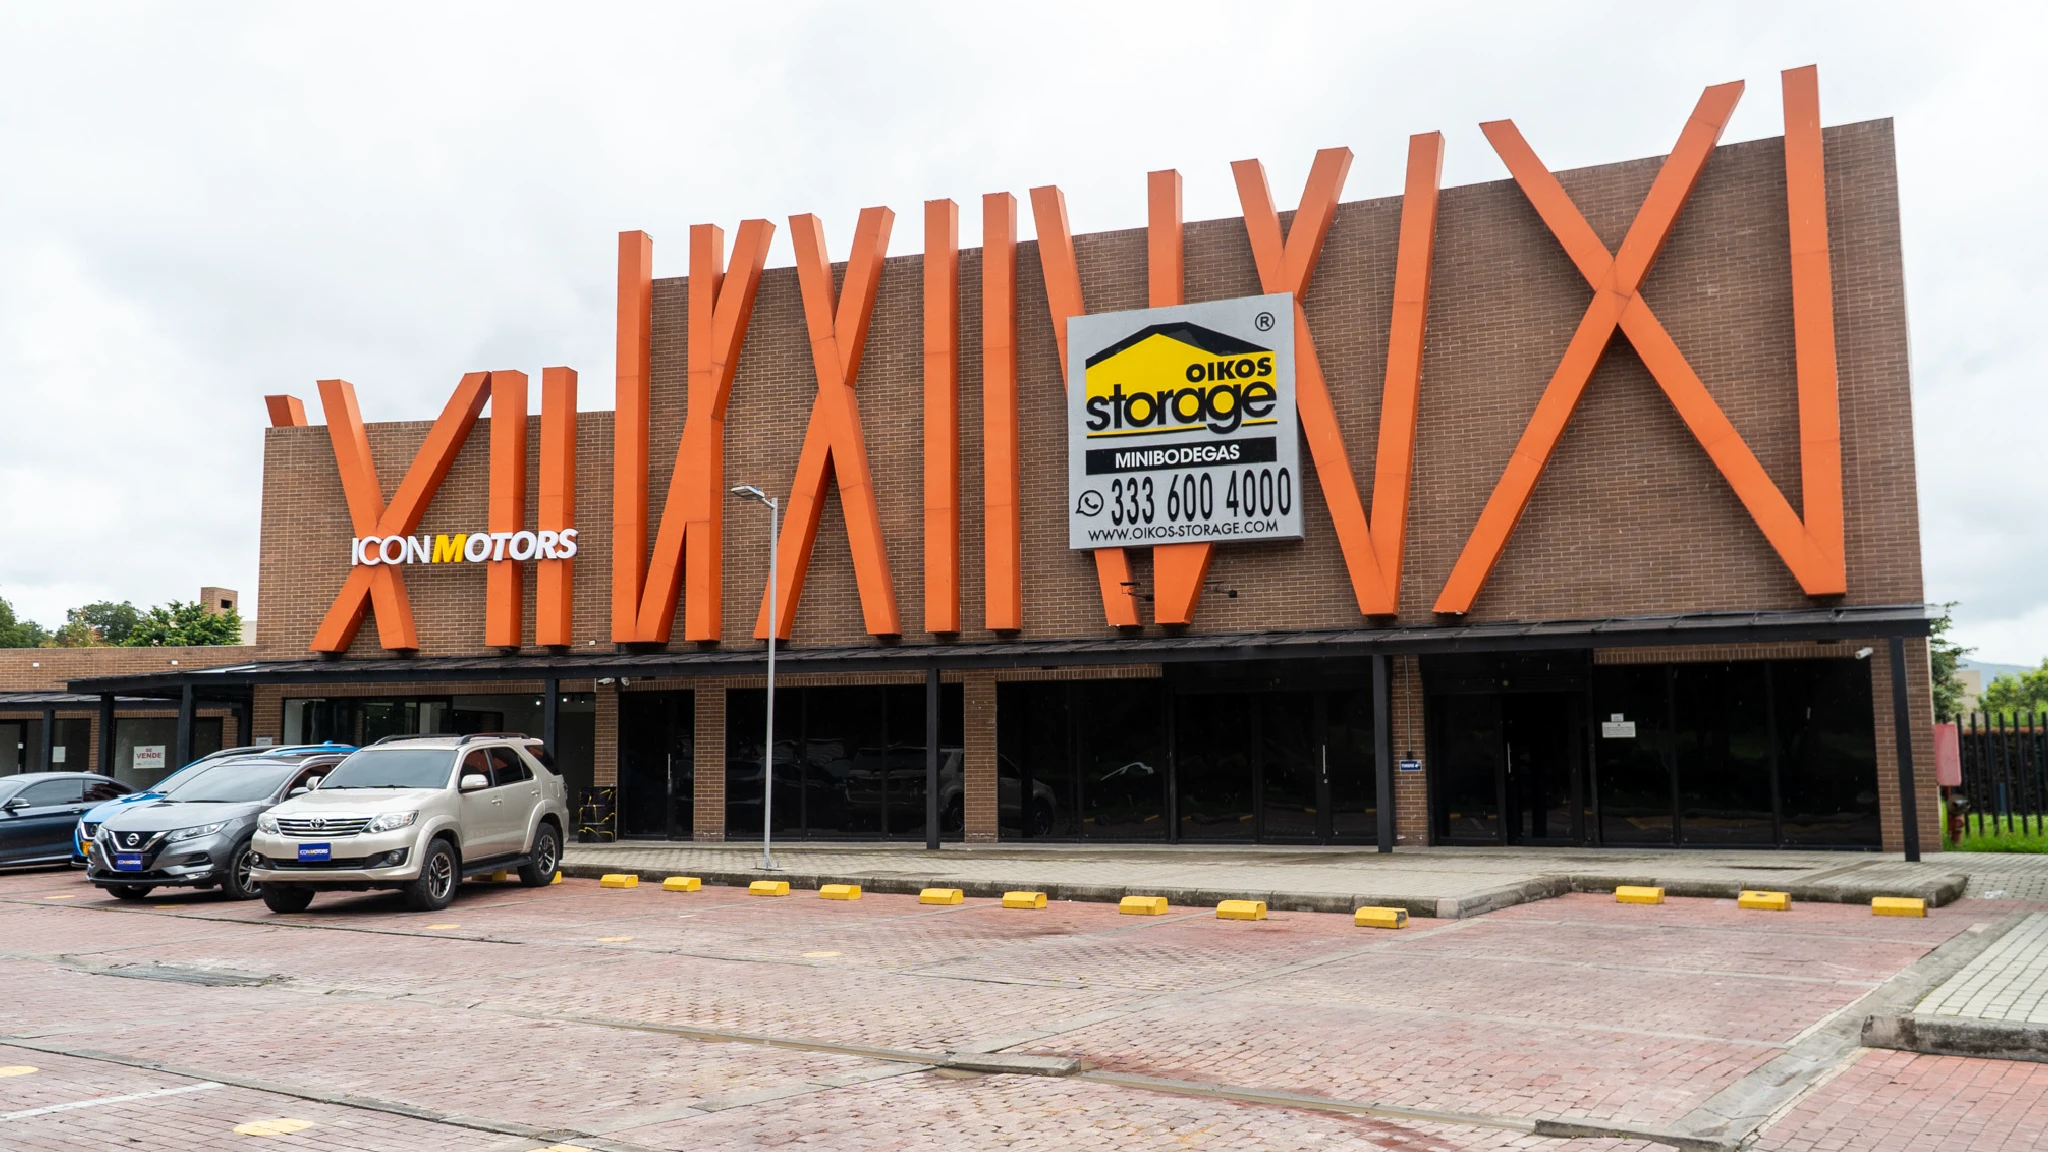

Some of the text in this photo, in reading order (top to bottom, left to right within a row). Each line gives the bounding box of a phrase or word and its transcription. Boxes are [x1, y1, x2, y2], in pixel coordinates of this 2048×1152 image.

[1185, 356, 1273, 383] OIKOS
[1086, 381, 1277, 435] storage
[1115, 444, 1240, 469] MINIBODEGAS
[1111, 467, 1291, 526] 333 600 4000
[1088, 518, 1279, 542] WWW.OIKOS-STORAGE.COM
[351, 528, 580, 566] ICONMOTORS
